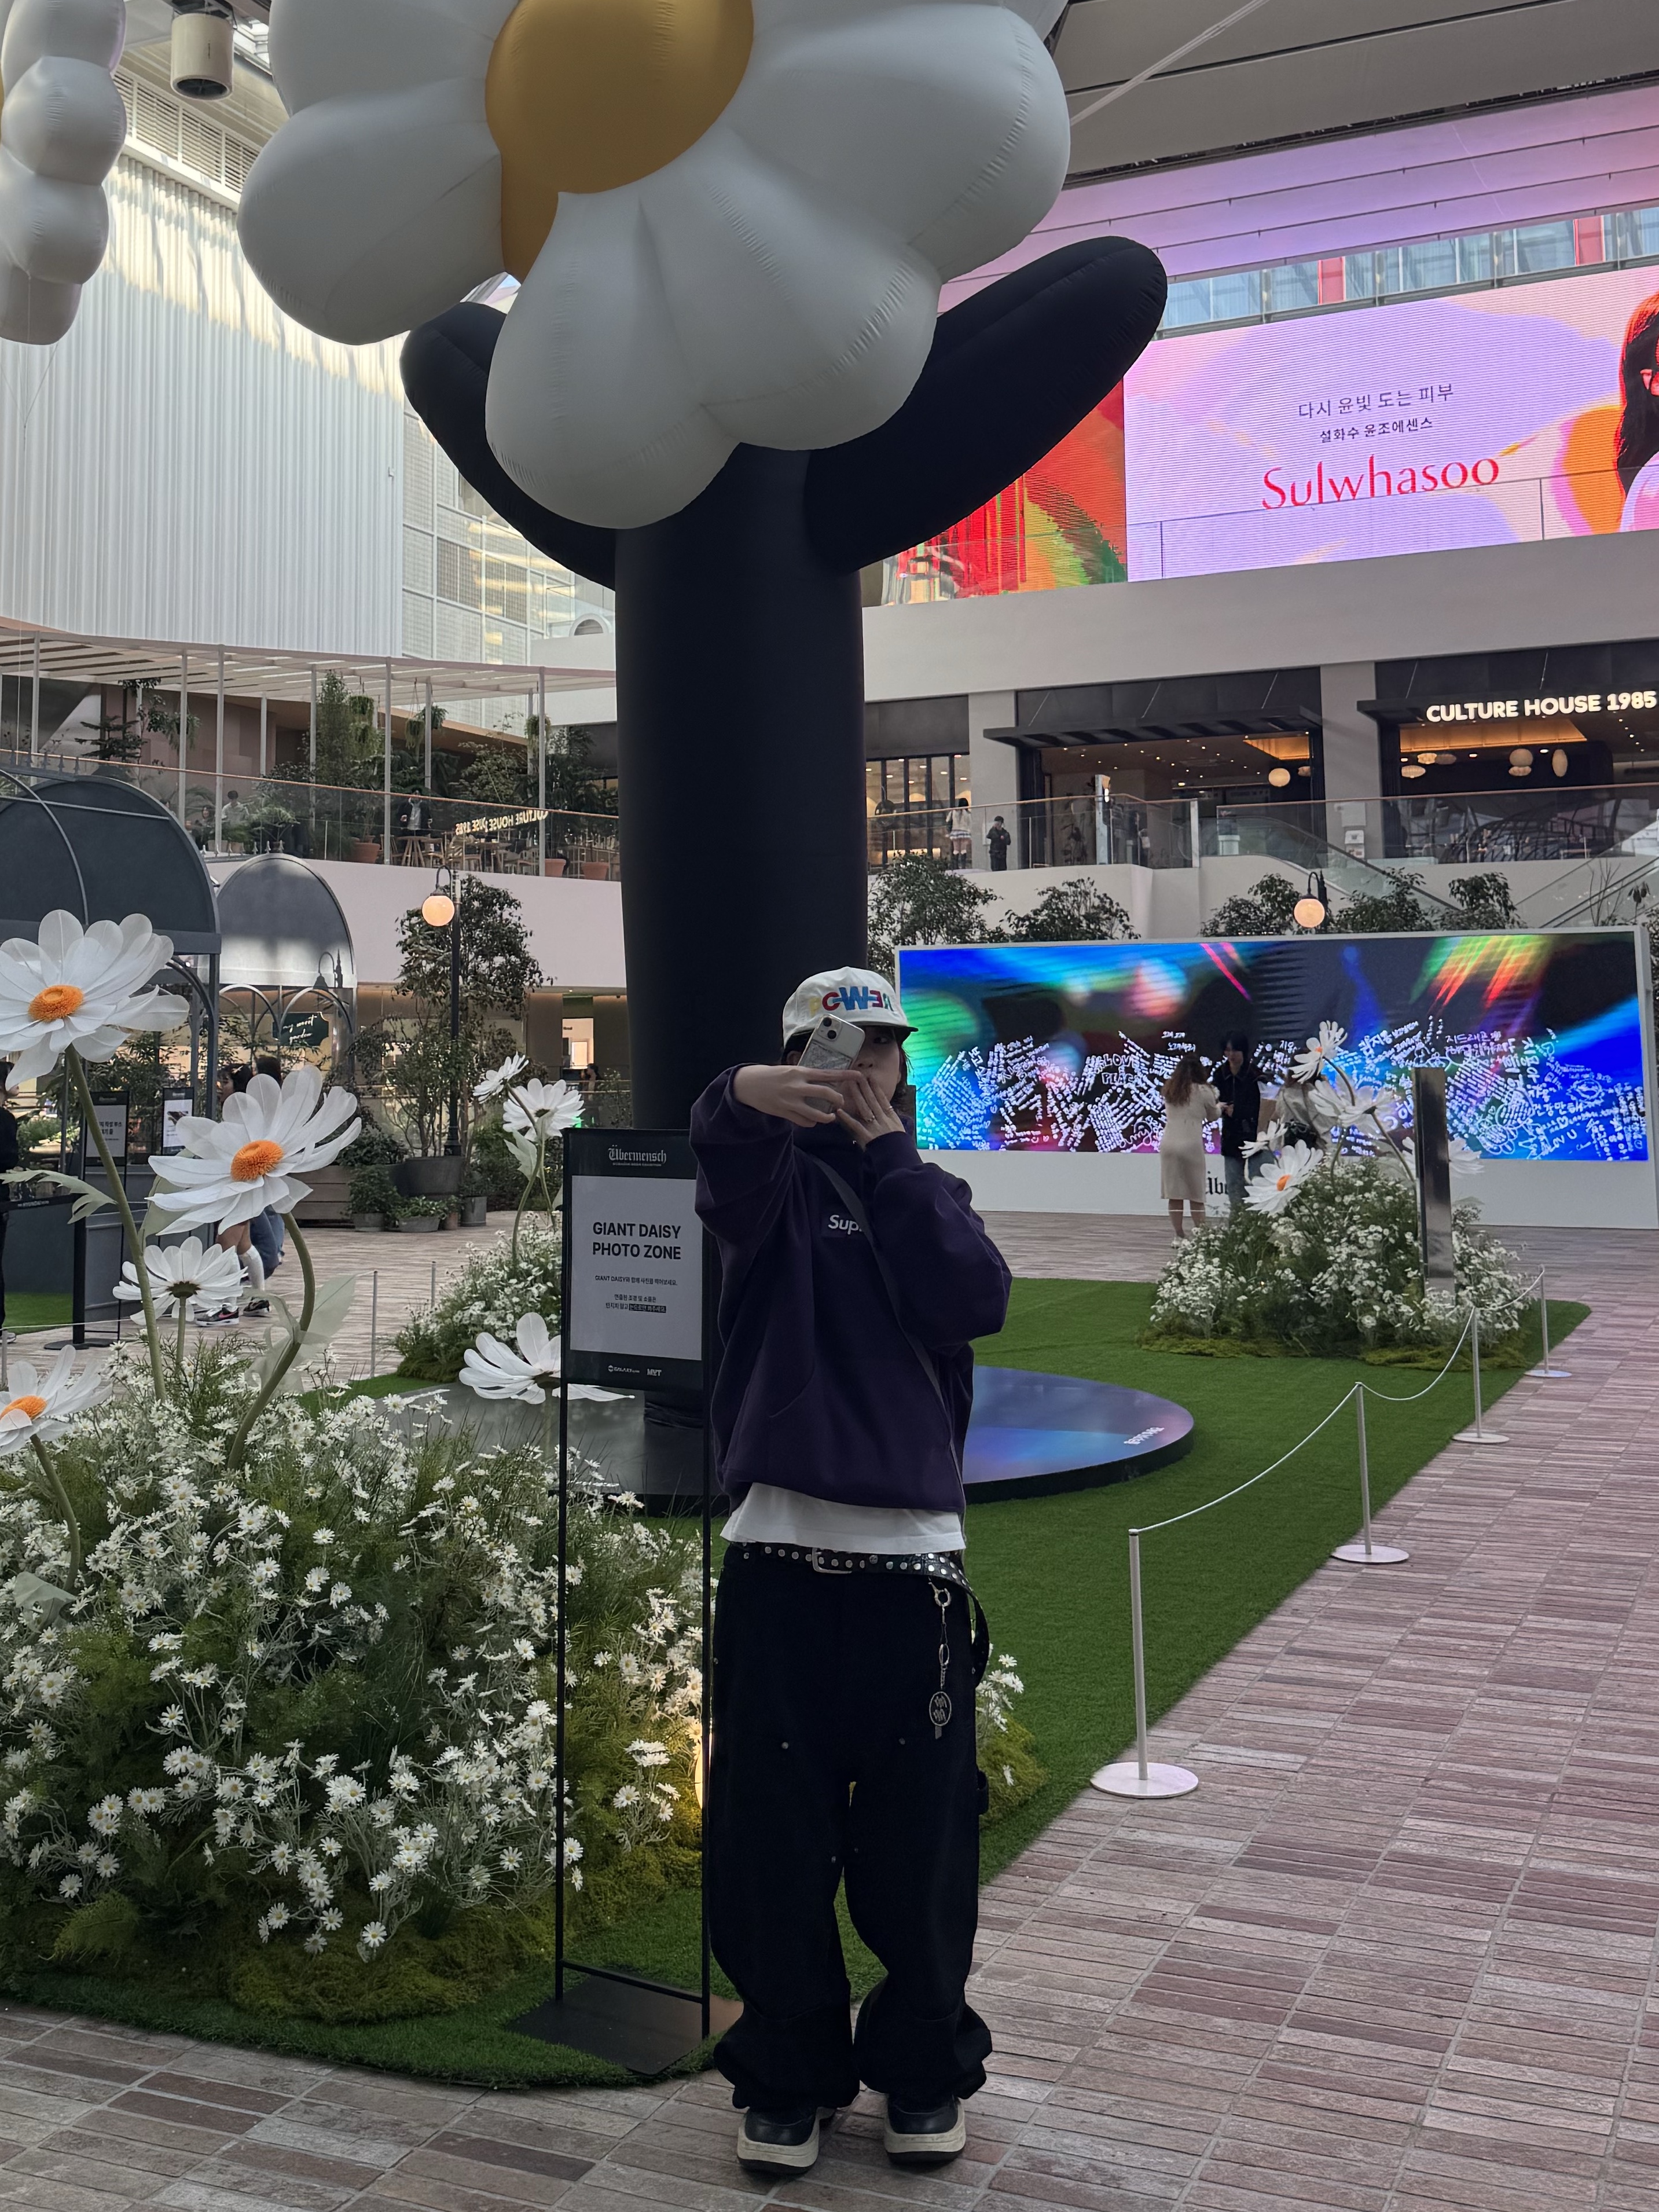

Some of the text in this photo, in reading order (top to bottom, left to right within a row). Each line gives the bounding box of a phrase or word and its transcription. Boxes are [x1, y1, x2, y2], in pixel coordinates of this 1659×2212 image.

[1298, 383, 1454, 419] 다시 윤빛 도는 피부
[1320, 417, 1433, 443] 설화수 윤조에센스
[1262, 454, 1499, 509] Sulwhasoo
[1426, 691, 1657, 722] CULTURE HOUSE 1985
[593, 1221, 681, 1239] GIANT DAISY
[592, 1242, 681, 1260] PHOTO ZONE
